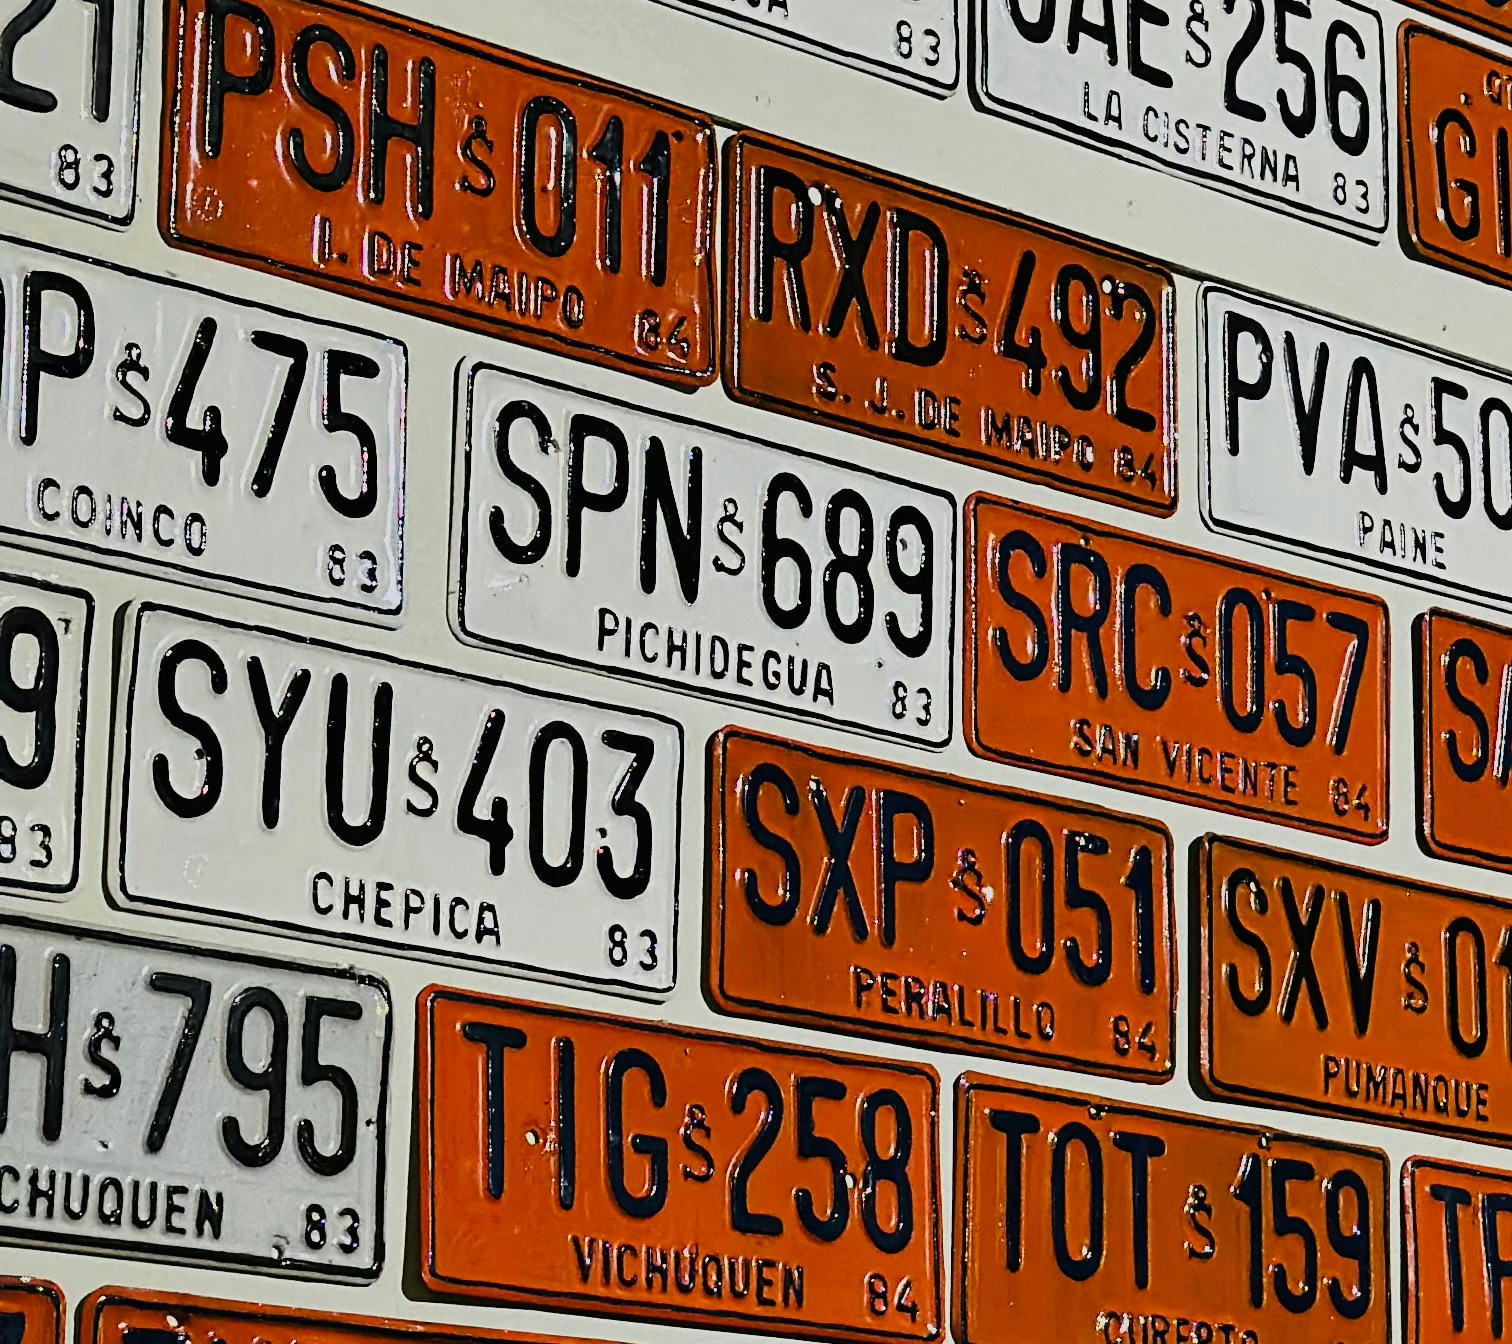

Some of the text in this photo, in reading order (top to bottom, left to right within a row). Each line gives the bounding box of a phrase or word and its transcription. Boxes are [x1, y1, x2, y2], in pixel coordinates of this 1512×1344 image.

[1083, 81, 1300, 192] LA CISTERNA
[38, 477, 208, 556] COINCO
[1357, 511, 1447, 570] PAINE
[598, 606, 835, 706] PICHIDEGUA
[1070, 718, 1300, 807] SAN VICENTE
[311, 868, 658, 972] CHEPICA 83
[850, 963, 1056, 1042] PERALILLO
[1322, 1054, 1490, 1123] PUMANQUE
[571, 1236, 804, 1309] VICHUQUEN
